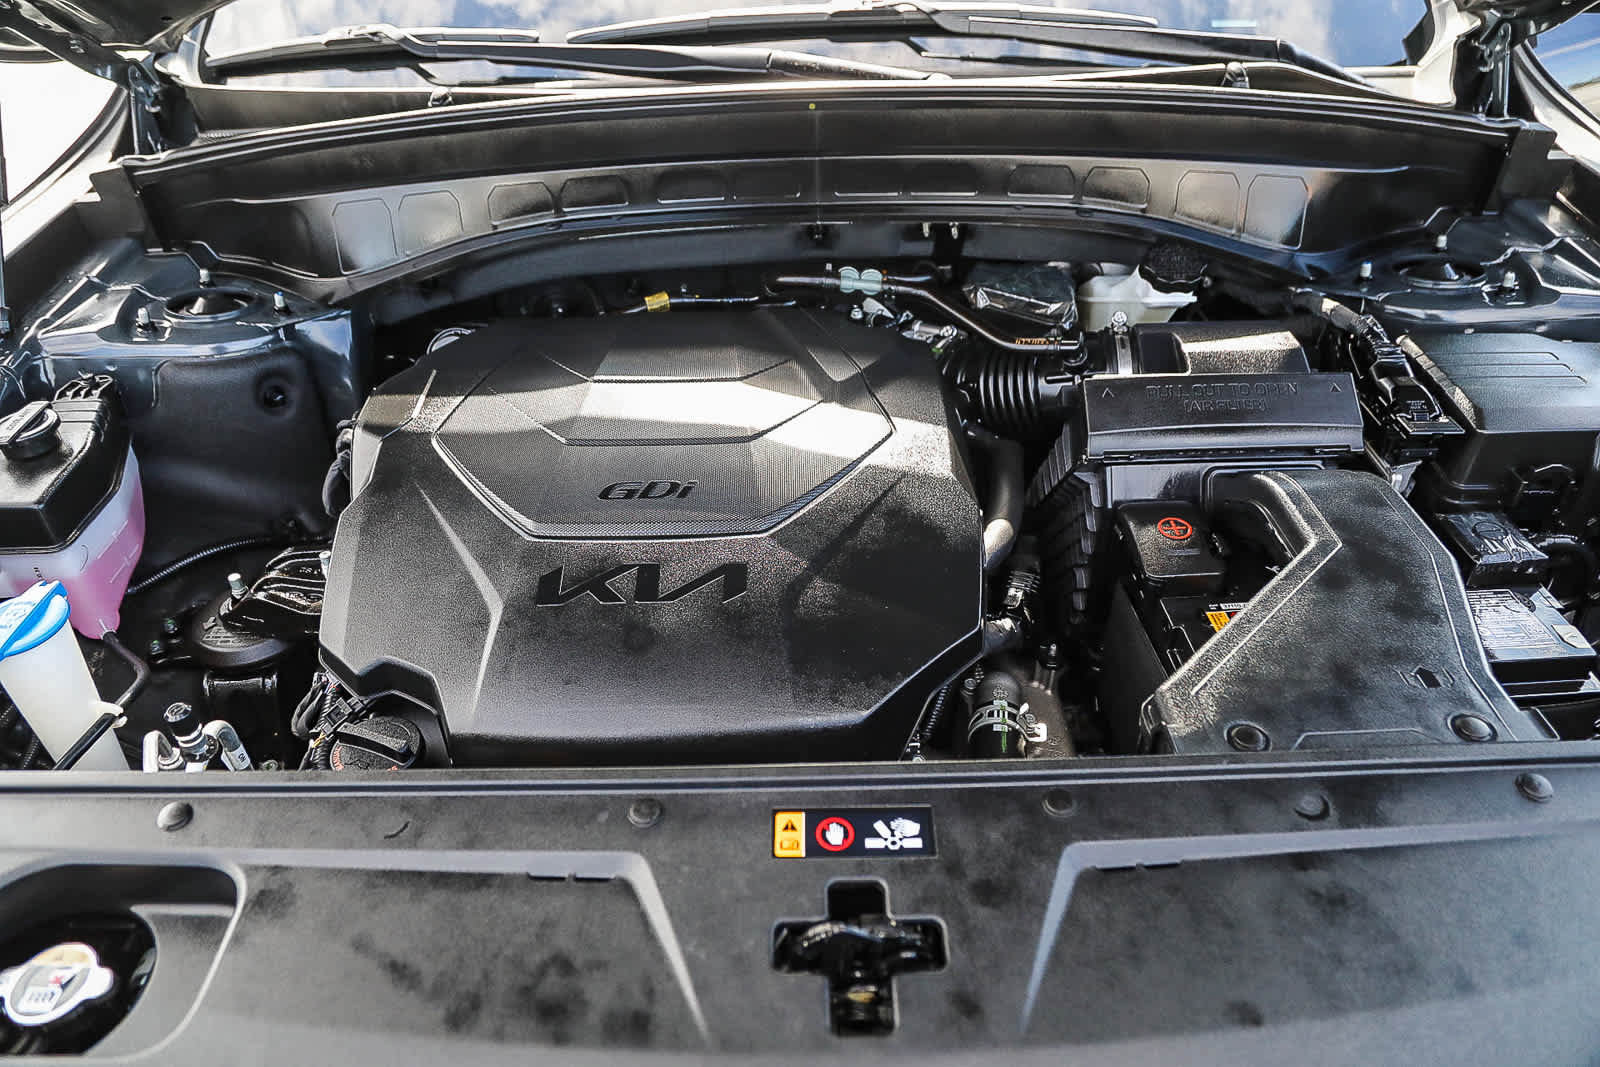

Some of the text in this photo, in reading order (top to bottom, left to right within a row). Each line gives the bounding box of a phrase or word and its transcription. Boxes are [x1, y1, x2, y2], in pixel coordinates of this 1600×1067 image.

[1191, 383, 1225, 397] OUT
[1227, 383, 1250, 395] TO
[1254, 382, 1298, 395] OPEN
[597, 479, 698, 501] GDi
[536, 562, 749, 608] KIA
